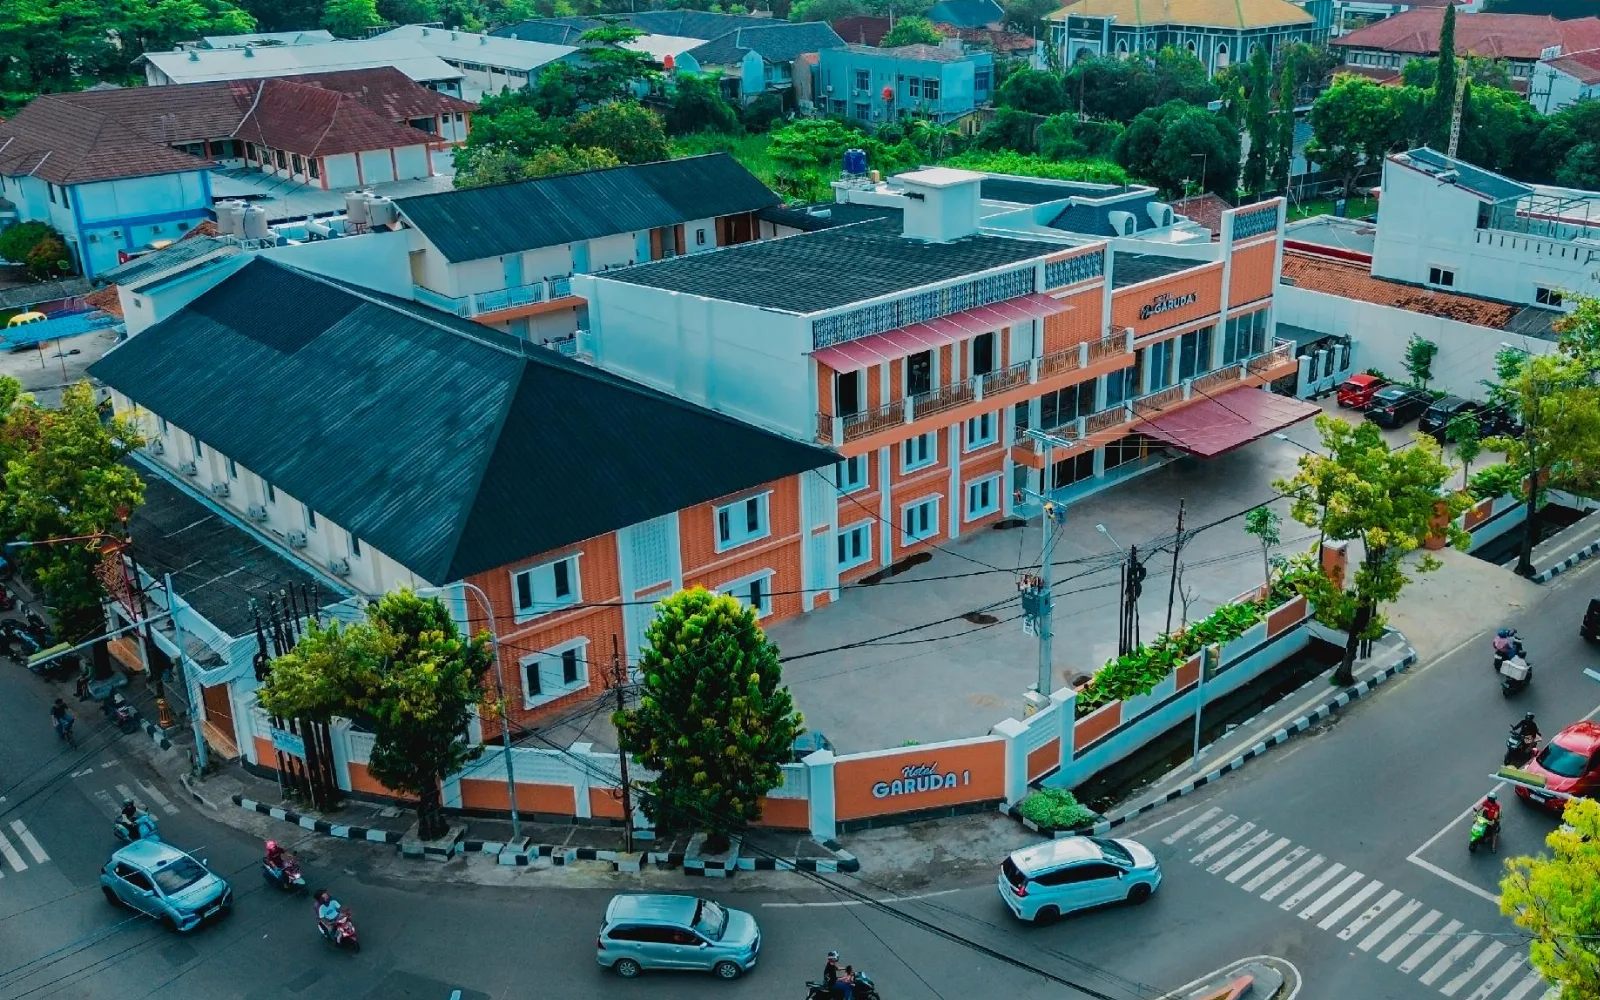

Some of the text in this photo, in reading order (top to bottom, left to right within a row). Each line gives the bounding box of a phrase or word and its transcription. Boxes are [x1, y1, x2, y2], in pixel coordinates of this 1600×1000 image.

[1154, 294, 1193, 314] GARUDA
[901, 761, 938, 778] Hotel
[872, 770, 970, 799] GARUDA 1
